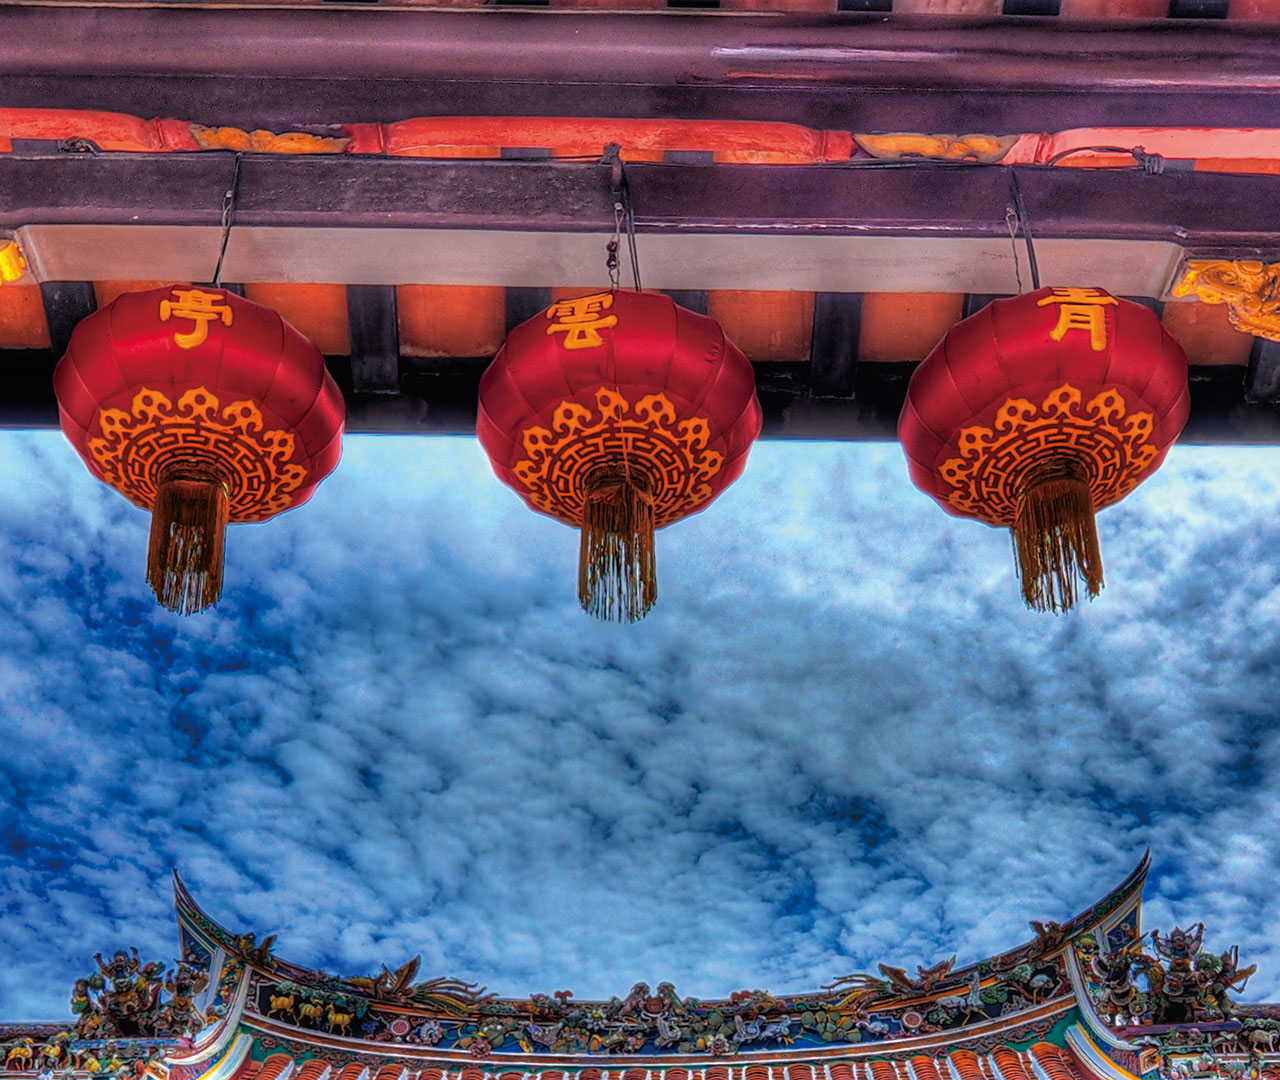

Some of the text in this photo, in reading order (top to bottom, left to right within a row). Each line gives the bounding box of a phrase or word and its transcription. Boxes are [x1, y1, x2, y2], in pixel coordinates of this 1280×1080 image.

[160, 287, 235, 349] 亭
[545, 293, 618, 351] 雲
[1037, 287, 1119, 353] 青
